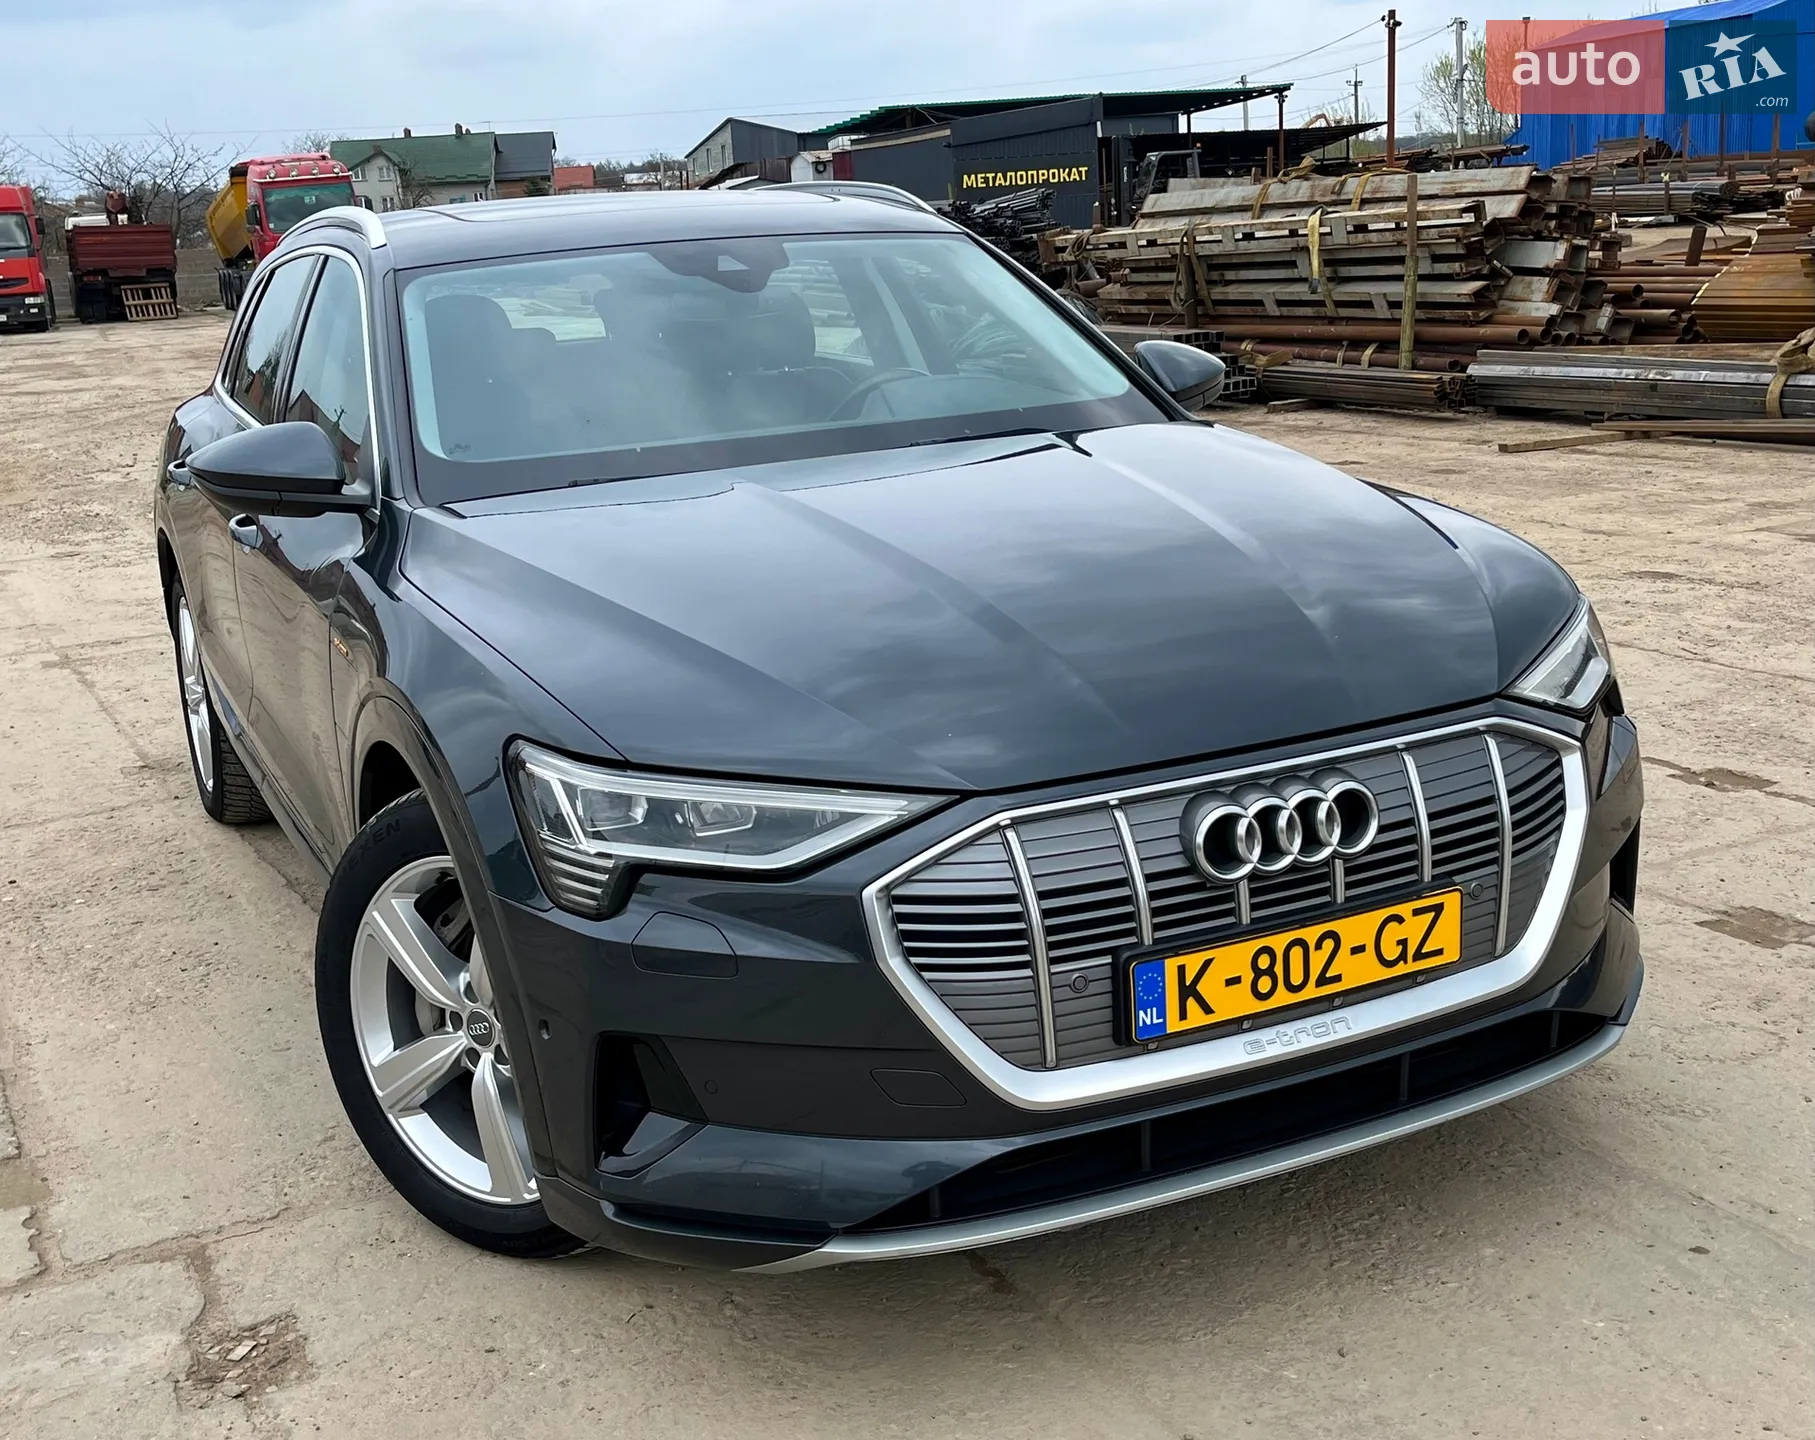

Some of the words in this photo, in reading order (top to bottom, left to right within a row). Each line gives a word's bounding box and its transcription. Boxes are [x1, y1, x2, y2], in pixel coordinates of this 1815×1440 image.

[963, 167, 1088, 188] МЕТАЛОПРОКАТ
[1177, 902, 1445, 1021] K-802-GZ
[1138, 1008, 1164, 1027] NL
[1243, 1016, 1352, 1055] e-tron
